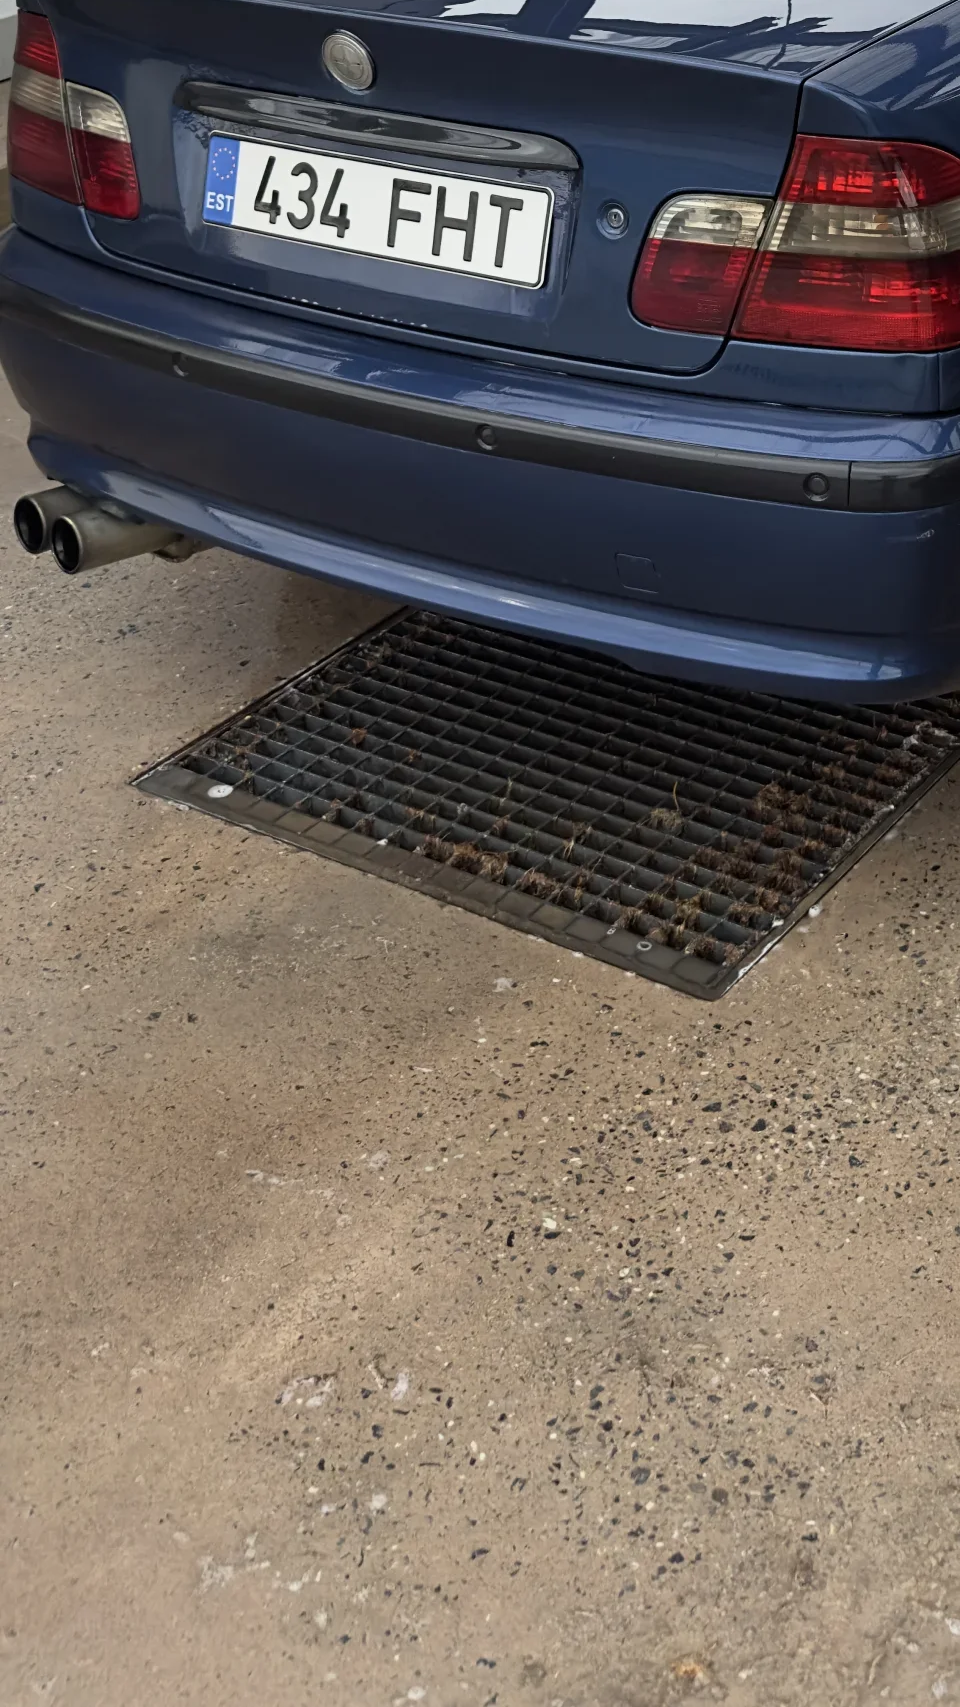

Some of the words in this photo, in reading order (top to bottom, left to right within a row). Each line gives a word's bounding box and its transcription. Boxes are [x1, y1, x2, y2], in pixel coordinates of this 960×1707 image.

[205, 191, 234, 213] EST
[253, 155, 350, 238] 434
[387, 177, 524, 268] FHT
